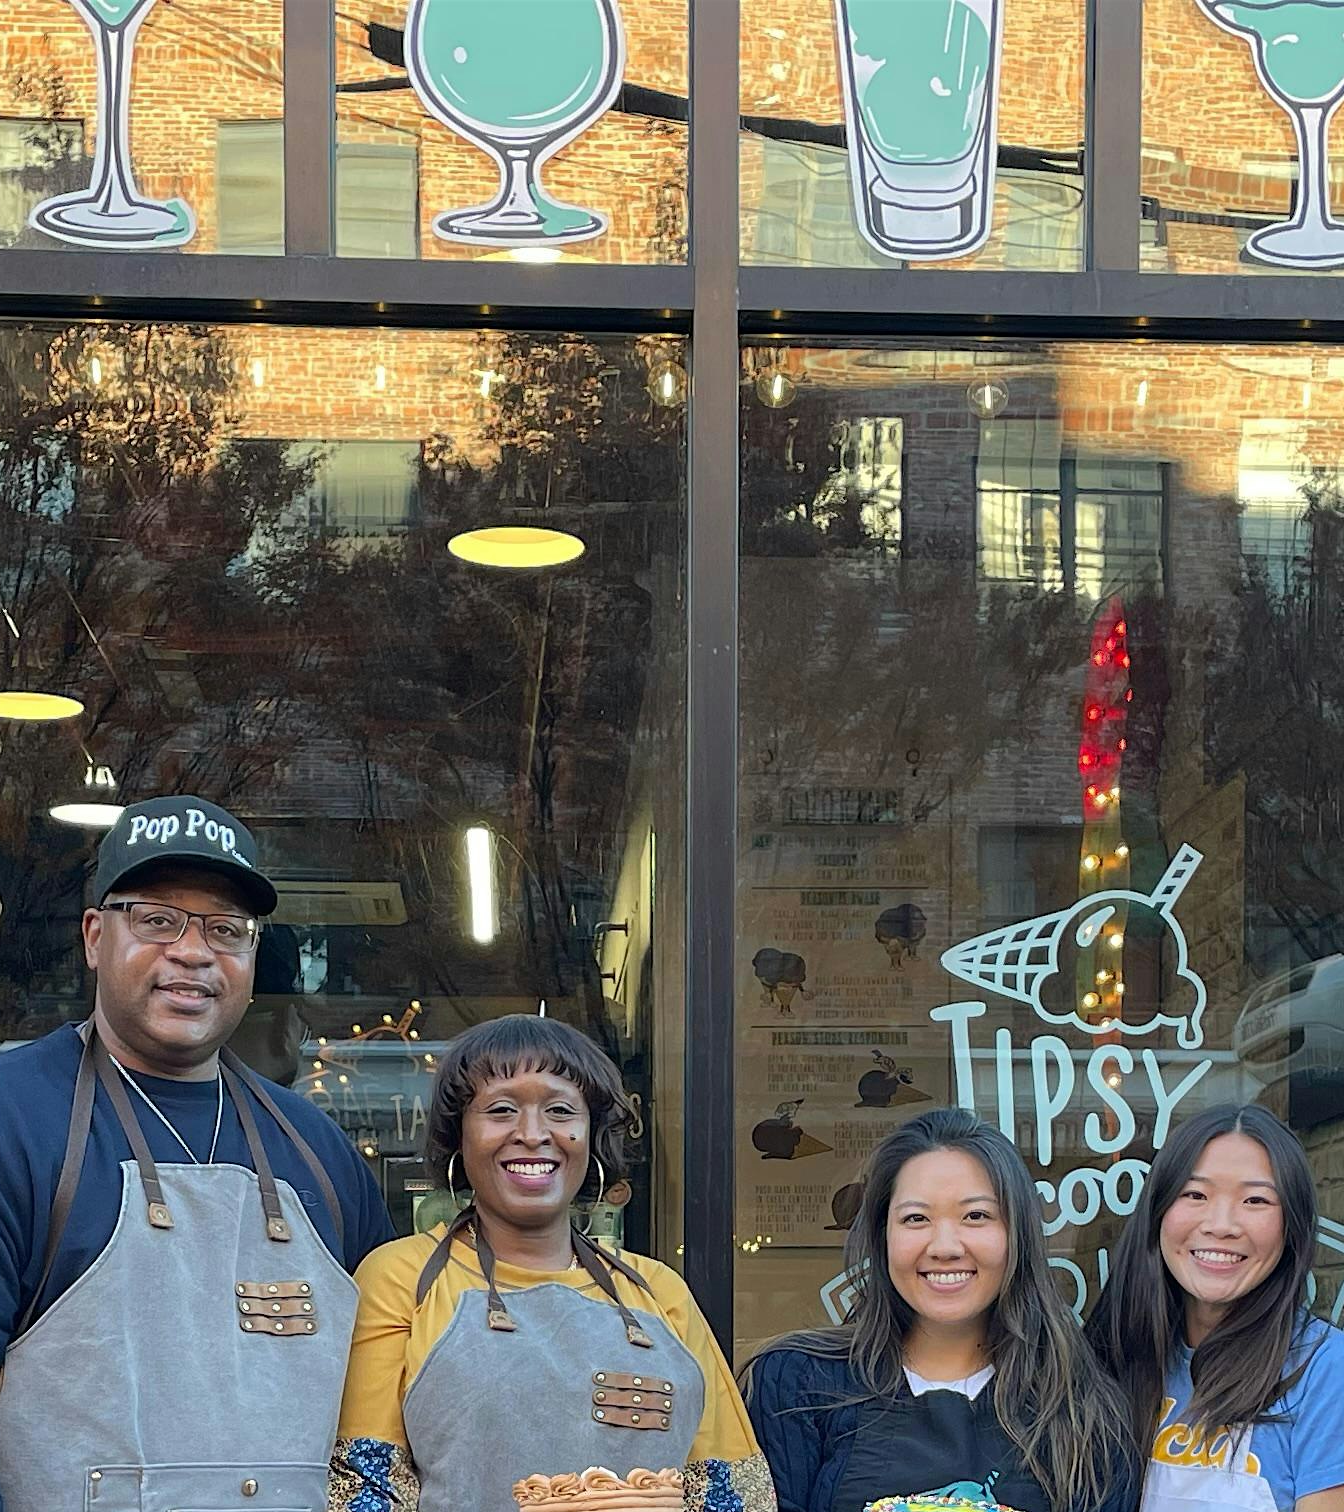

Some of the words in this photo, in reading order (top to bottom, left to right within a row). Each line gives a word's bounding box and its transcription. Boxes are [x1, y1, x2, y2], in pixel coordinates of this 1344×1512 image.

[126, 815, 180, 845] Pop
[184, 808, 236, 852] Pop
[930, 1001, 1212, 1167] TIPSY
